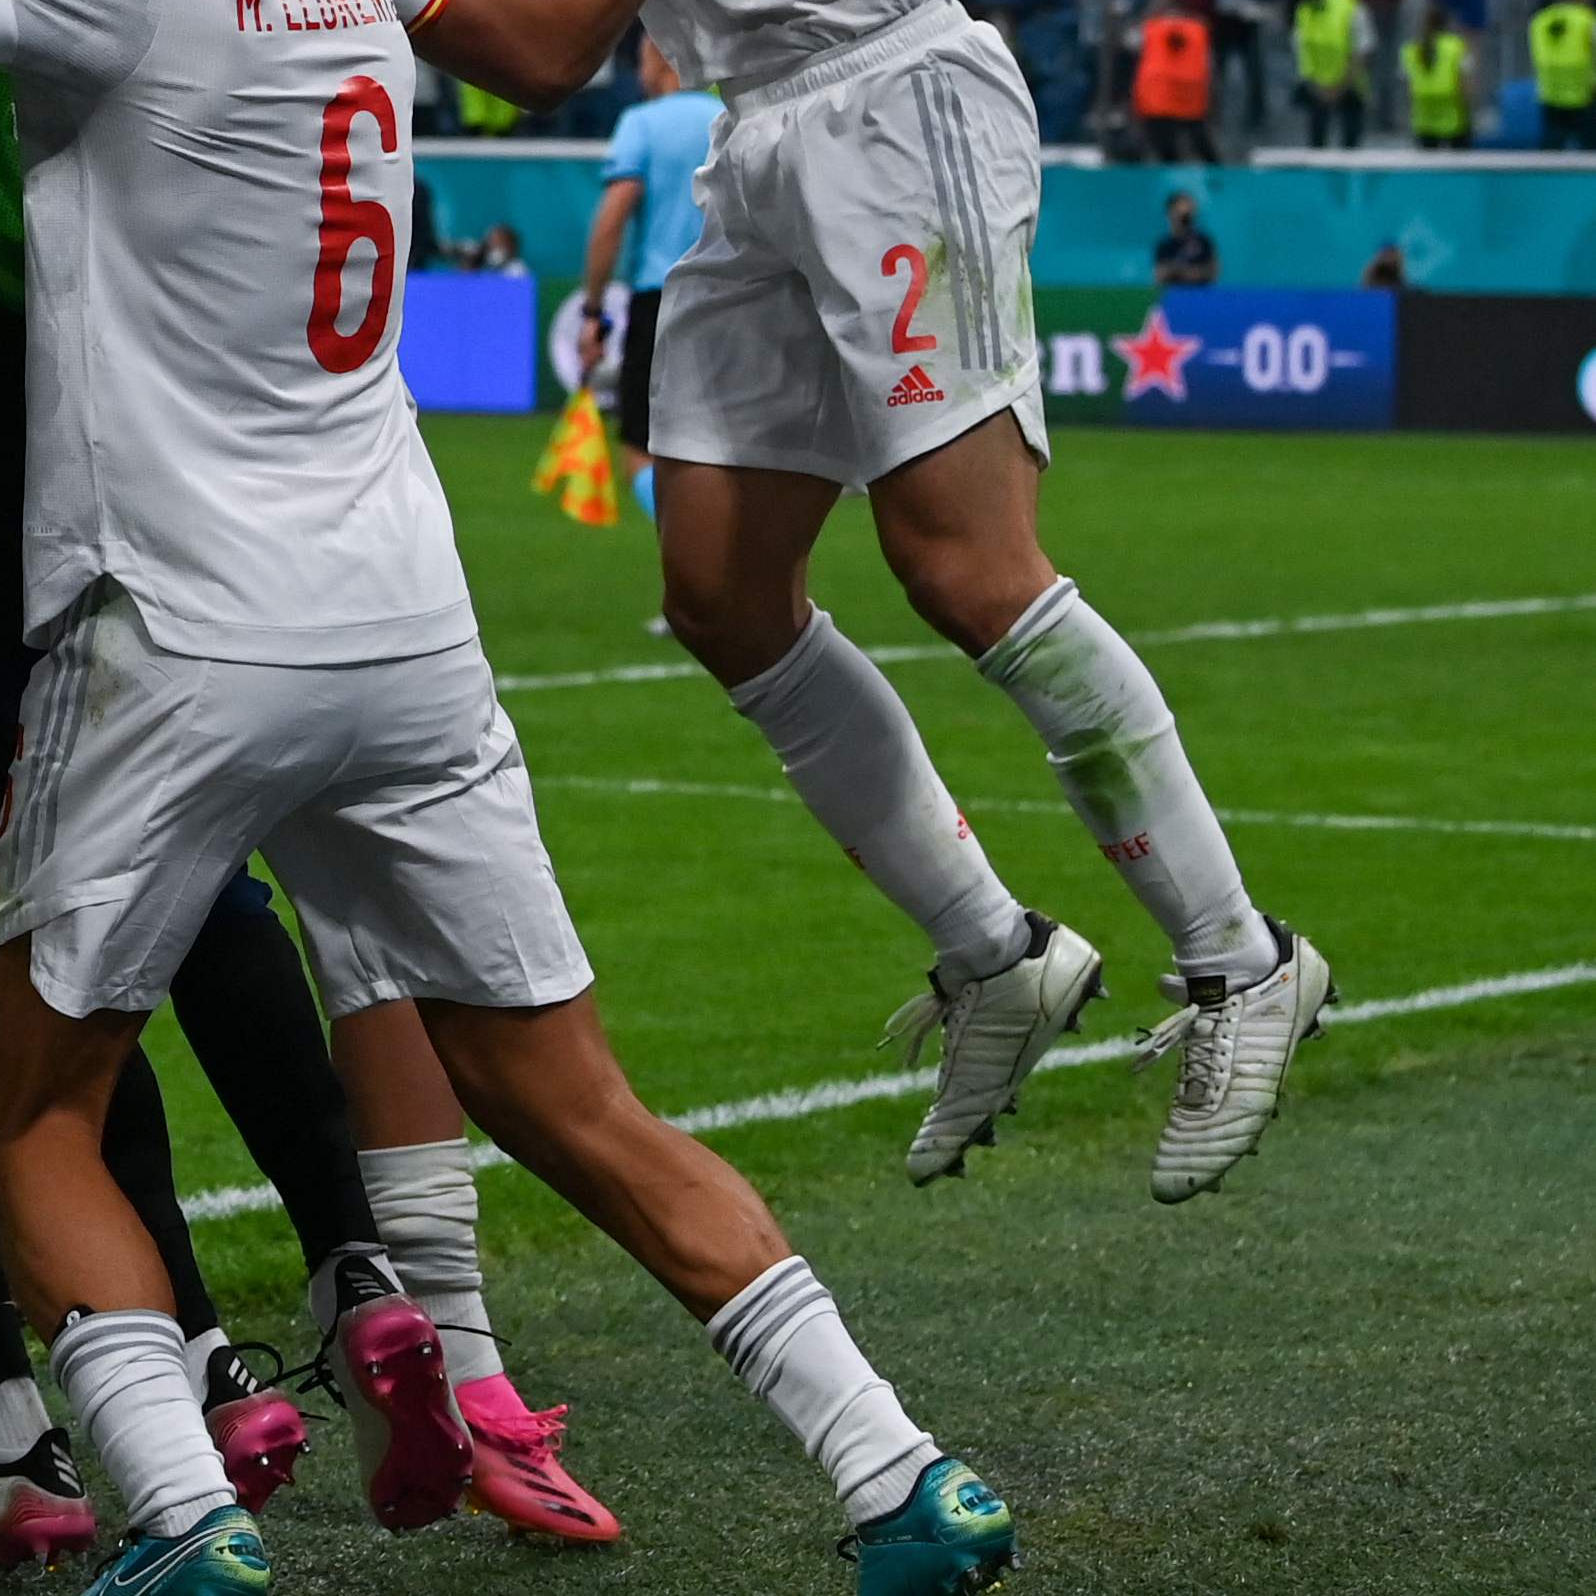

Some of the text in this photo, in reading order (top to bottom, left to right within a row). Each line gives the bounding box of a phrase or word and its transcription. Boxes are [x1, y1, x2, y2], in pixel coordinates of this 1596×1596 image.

[306, 75, 398, 374] 6
[881, 243, 938, 355] 2
[887, 388, 945, 408] adidas
